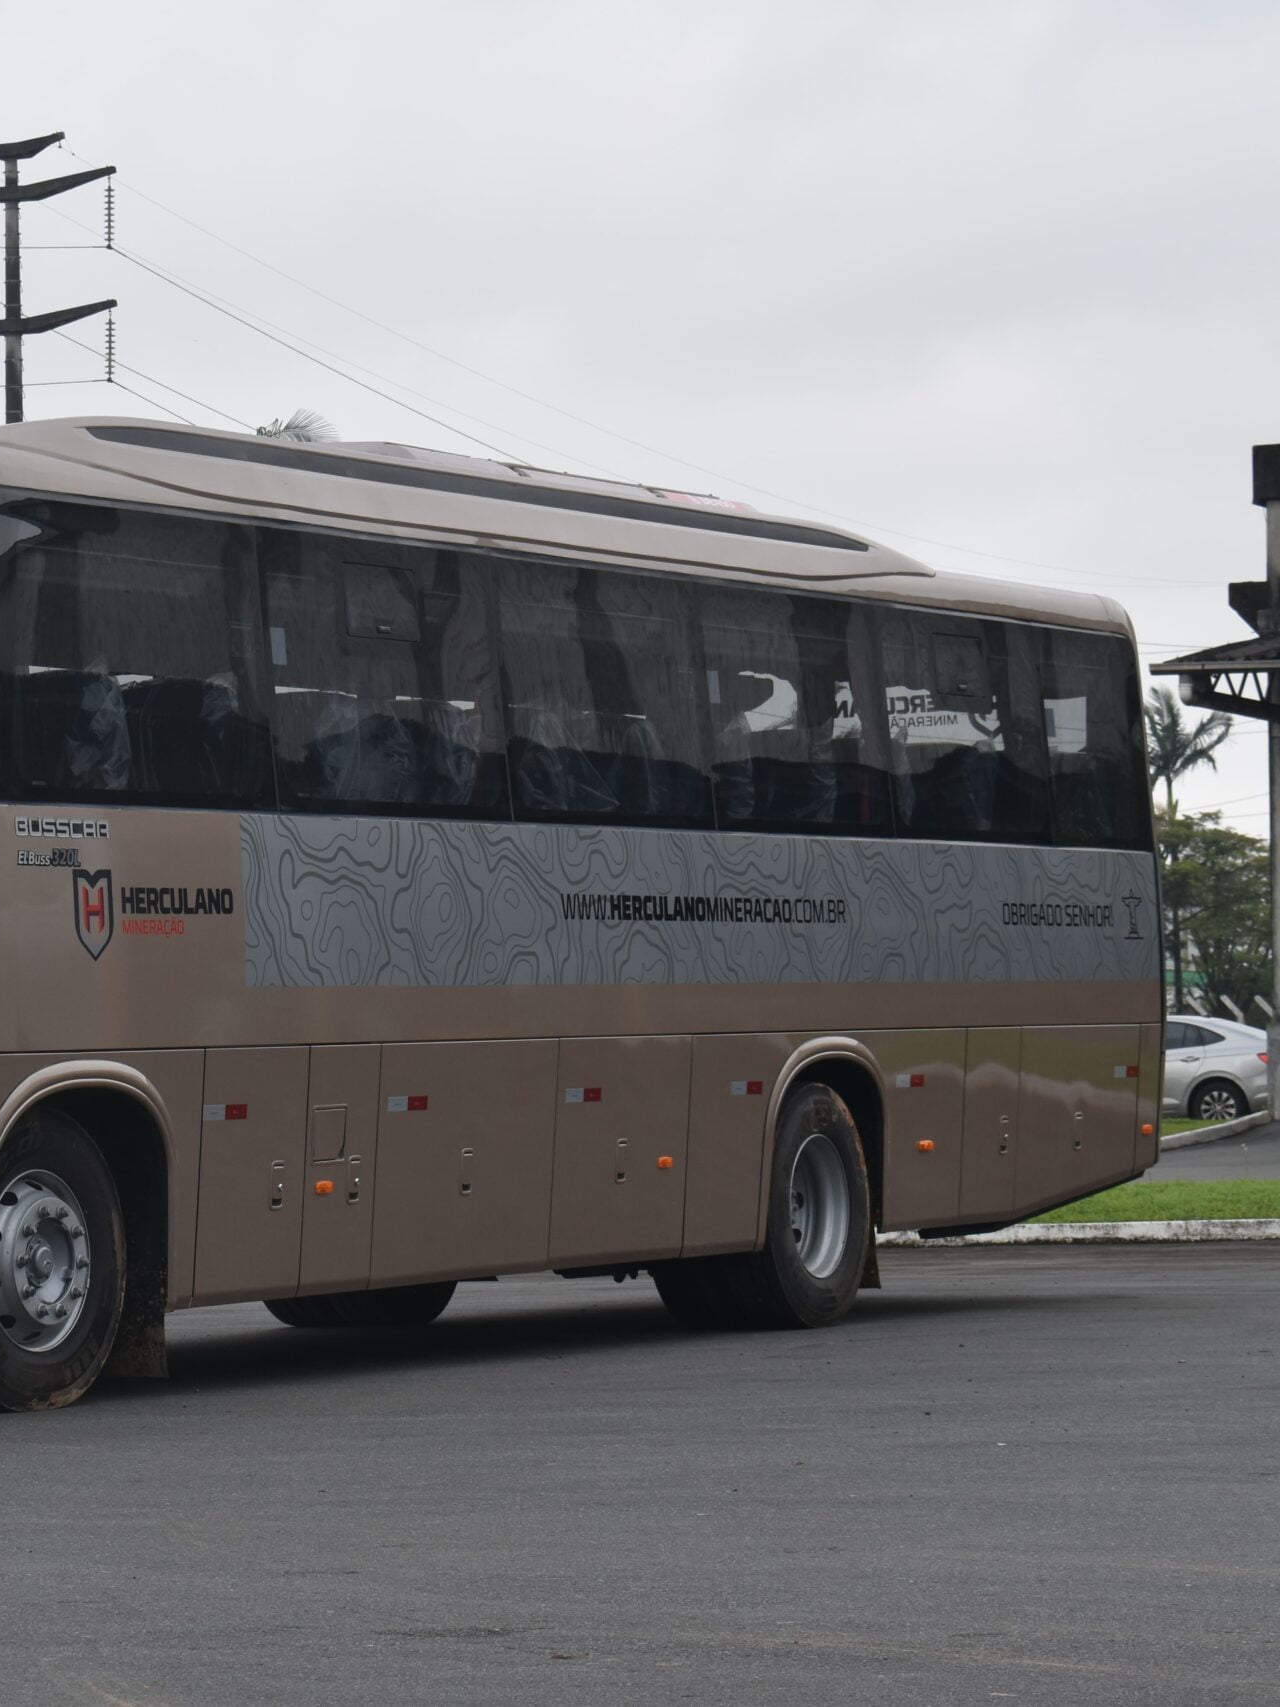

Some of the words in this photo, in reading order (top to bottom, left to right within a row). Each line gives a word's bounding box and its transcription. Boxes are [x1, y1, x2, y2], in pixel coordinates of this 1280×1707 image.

[14, 816, 110, 839] BUSSCAR
[52, 848, 81, 867] 320L
[120, 886, 234, 915] HERCULANO
[559, 893, 847, 924] WWW.HERCULANOMINERACAO.COM.BR
[1002, 902, 1063, 927] OBRIGADO
[122, 915, 185, 939] MINERAÇÃO
